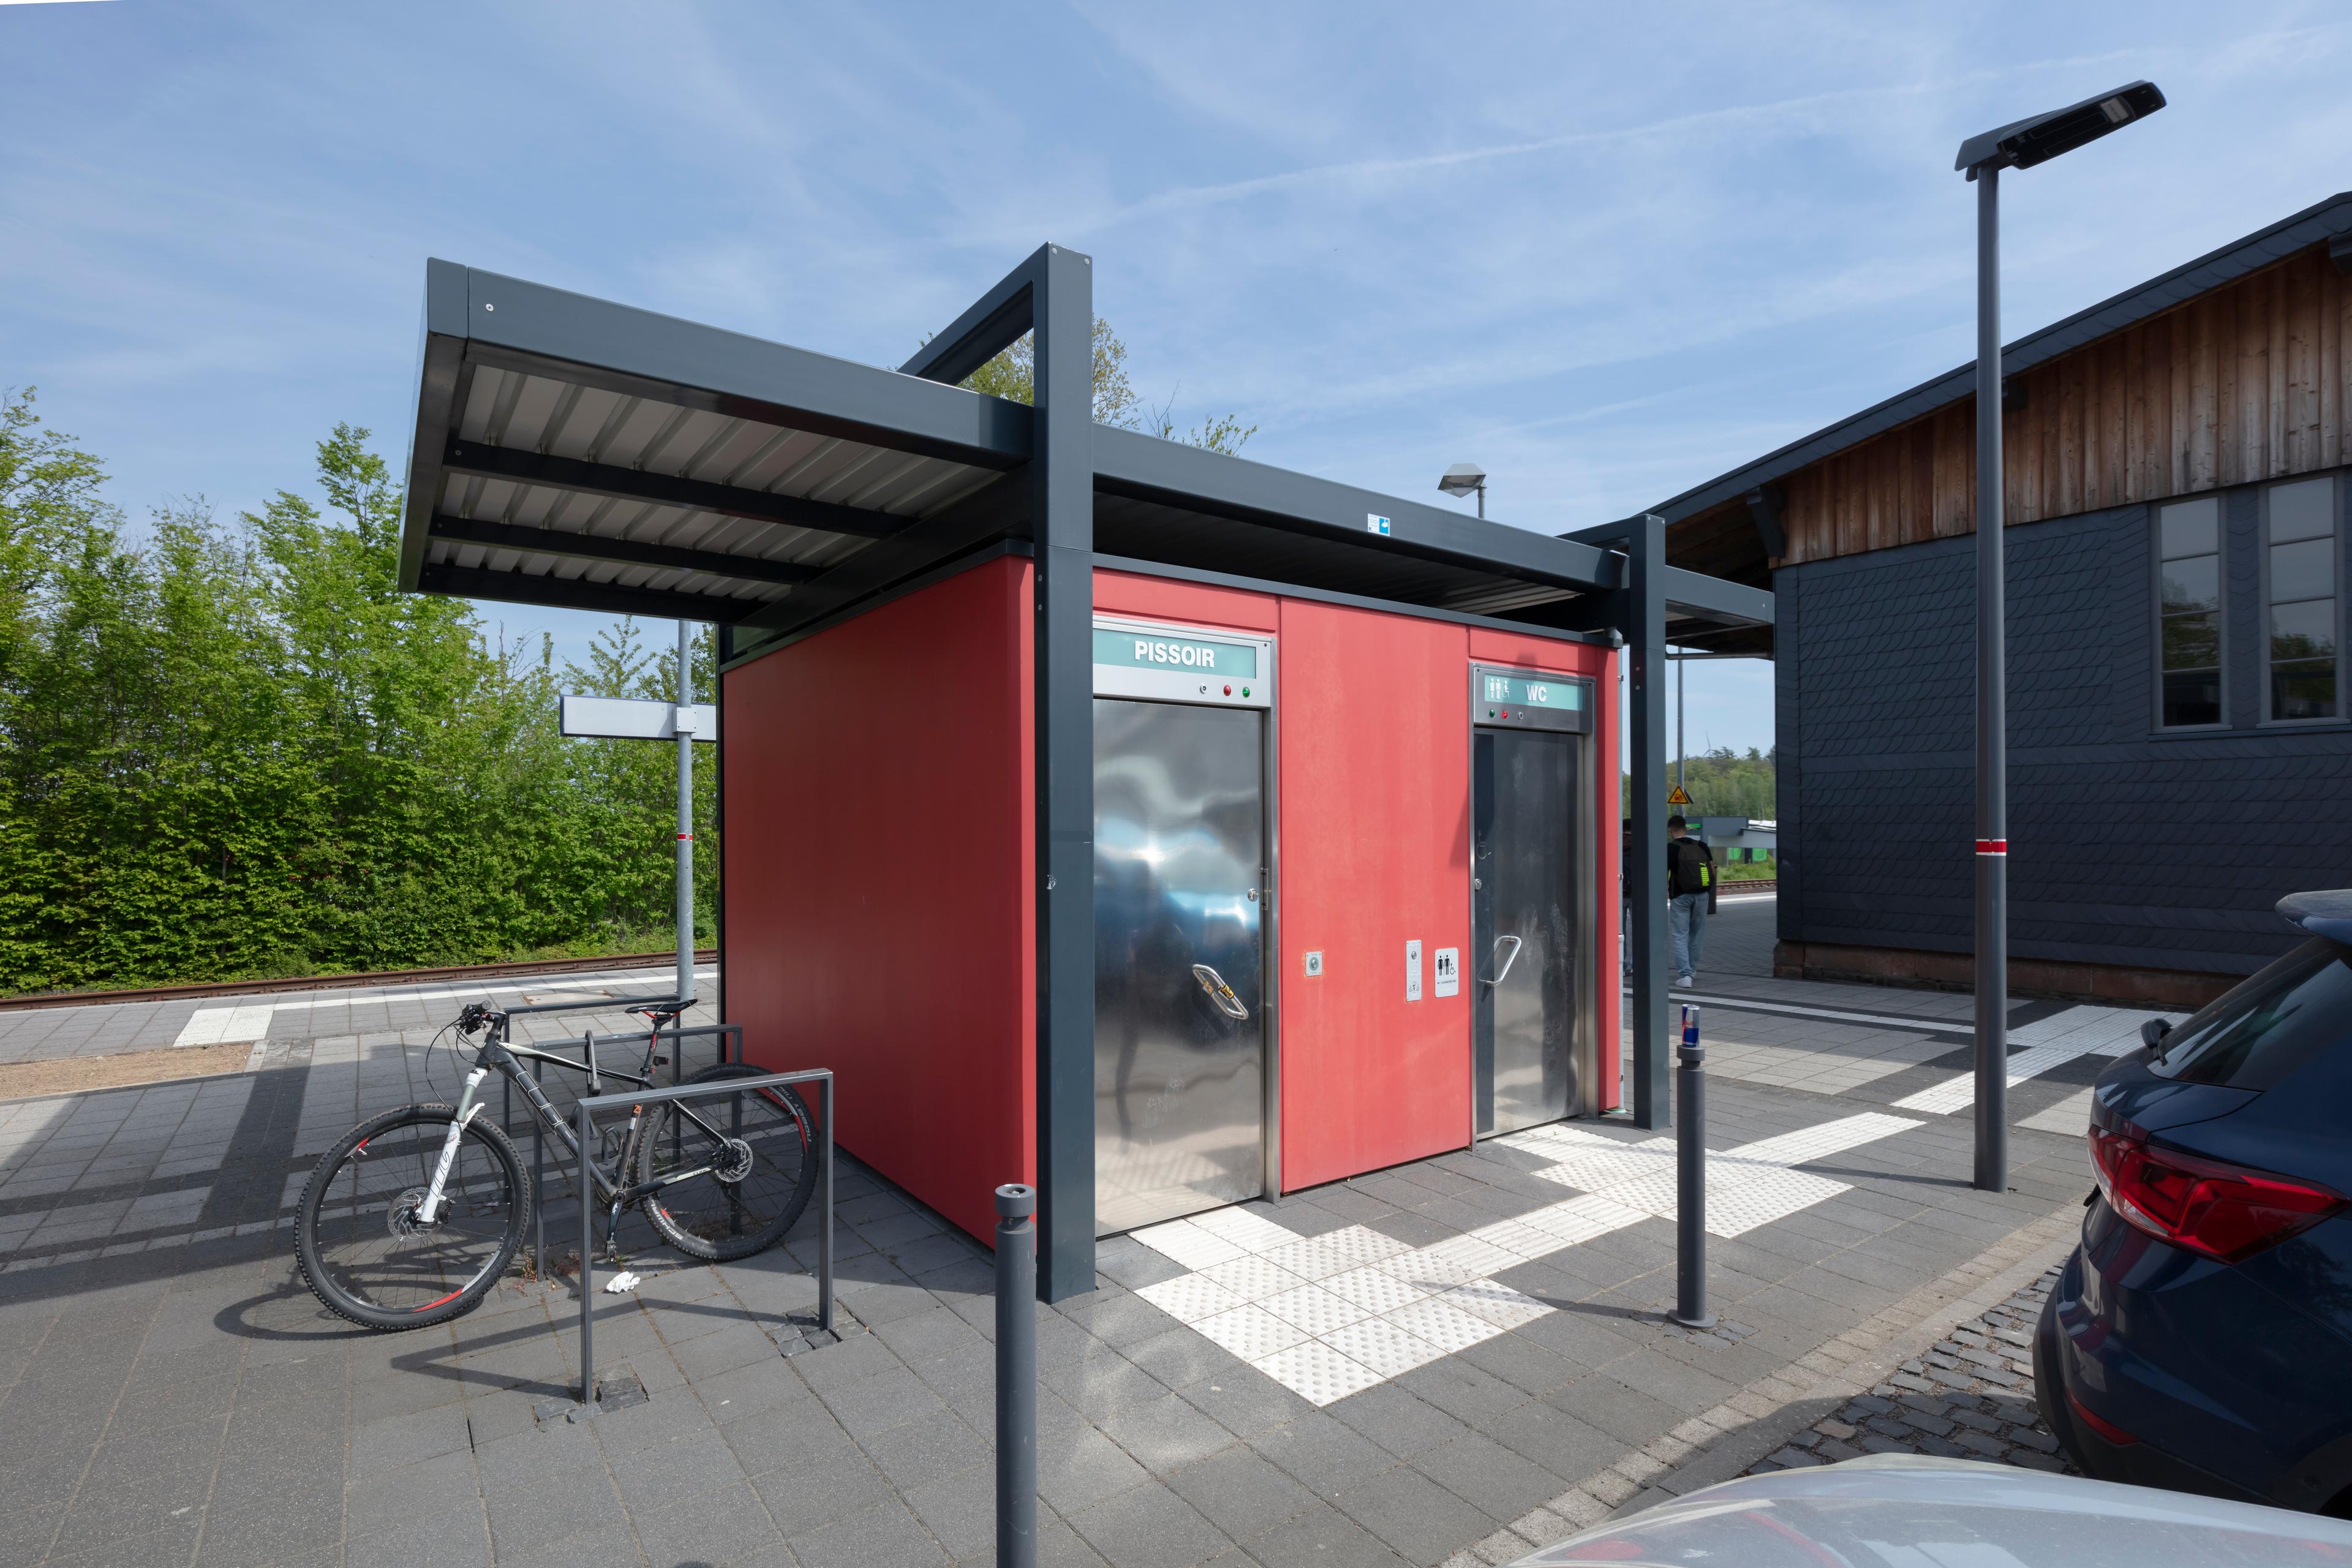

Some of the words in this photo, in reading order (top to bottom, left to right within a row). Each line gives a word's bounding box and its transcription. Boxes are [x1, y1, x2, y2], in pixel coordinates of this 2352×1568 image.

[1135, 641, 1214, 668] PISSOIR
[1526, 684, 1547, 702] WC
[794, 1103, 812, 1142] NOBBY
[649, 1198, 684, 1240] SCHWAL
